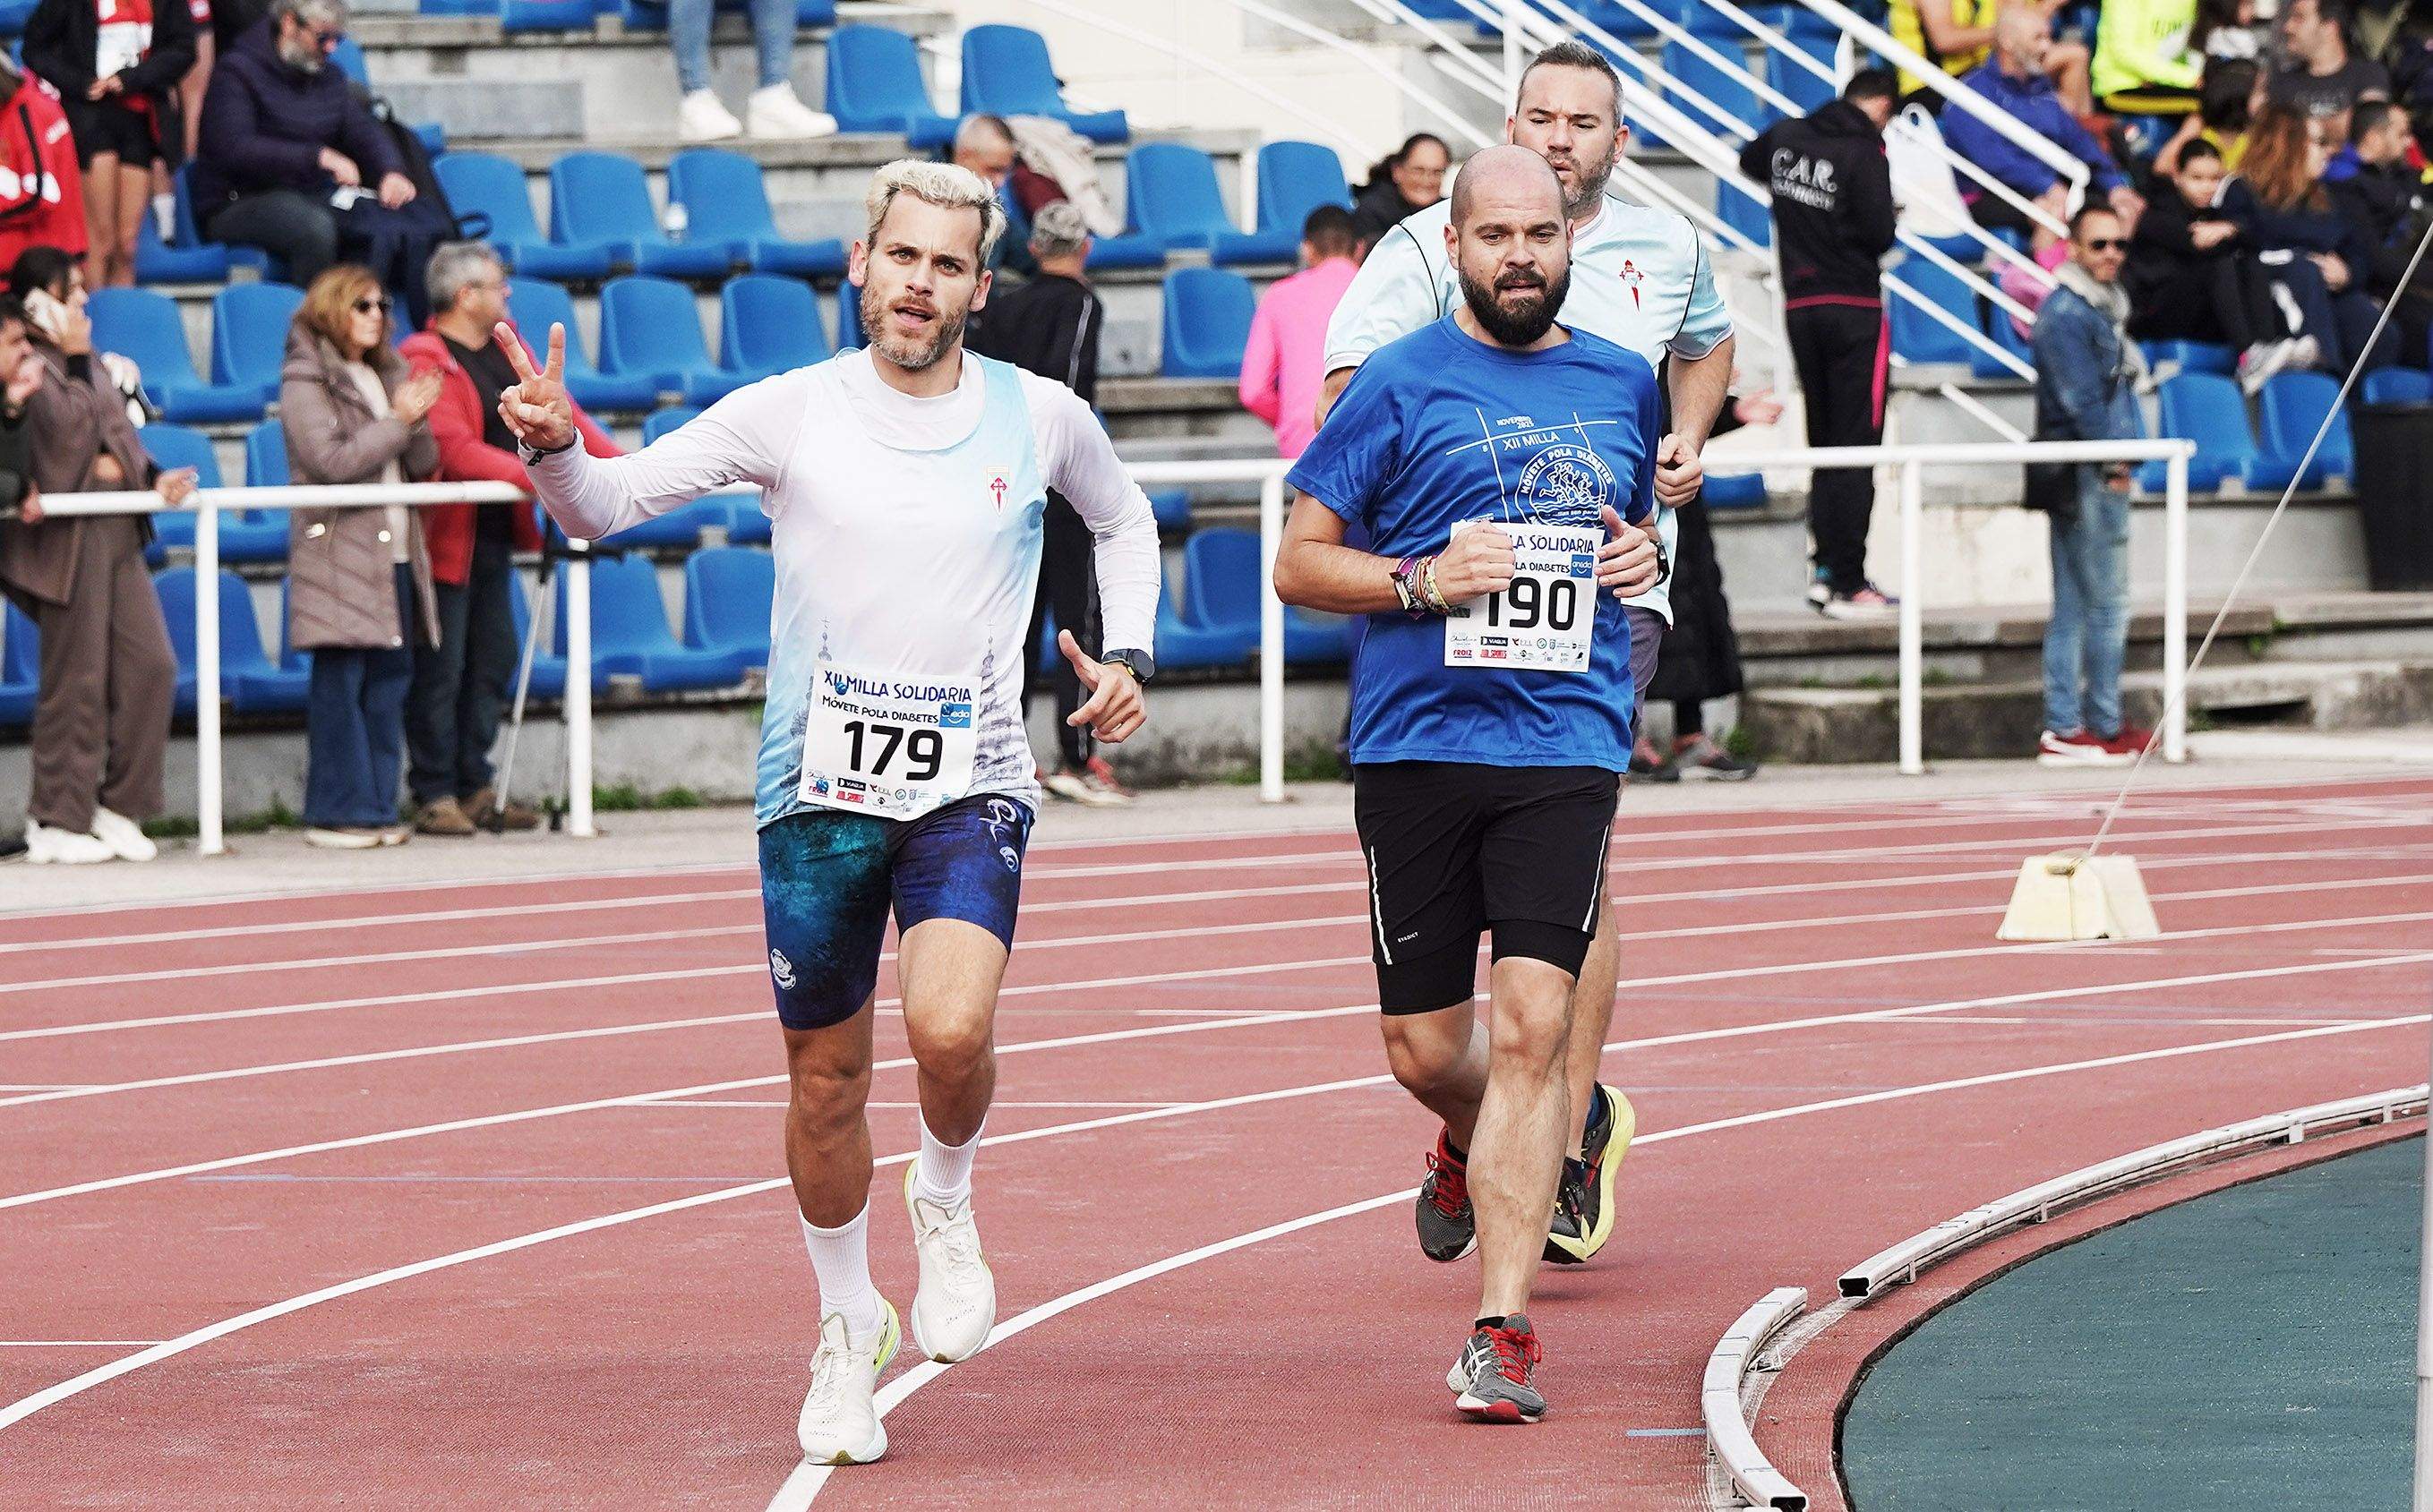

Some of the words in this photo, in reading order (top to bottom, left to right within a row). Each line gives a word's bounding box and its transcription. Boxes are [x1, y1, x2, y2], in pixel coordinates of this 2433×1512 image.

[1503, 436, 1521, 451] XII
[1522, 431, 1560, 447] MILLA
[1547, 448, 1572, 460] POLA
[1577, 449, 1613, 484] DIABETES
[1529, 535, 1594, 553] SOLIDARIA
[1529, 562, 1570, 573] DIABETES
[1488, 577, 1576, 630] 190
[845, 676, 889, 697] MILLA
[894, 683, 972, 703] SOLIDARIA
[822, 695, 860, 714] MÓVETE
[861, 706, 888, 719] POLA
[892, 711, 938, 723] DIABETES
[844, 721, 943, 781] 179
